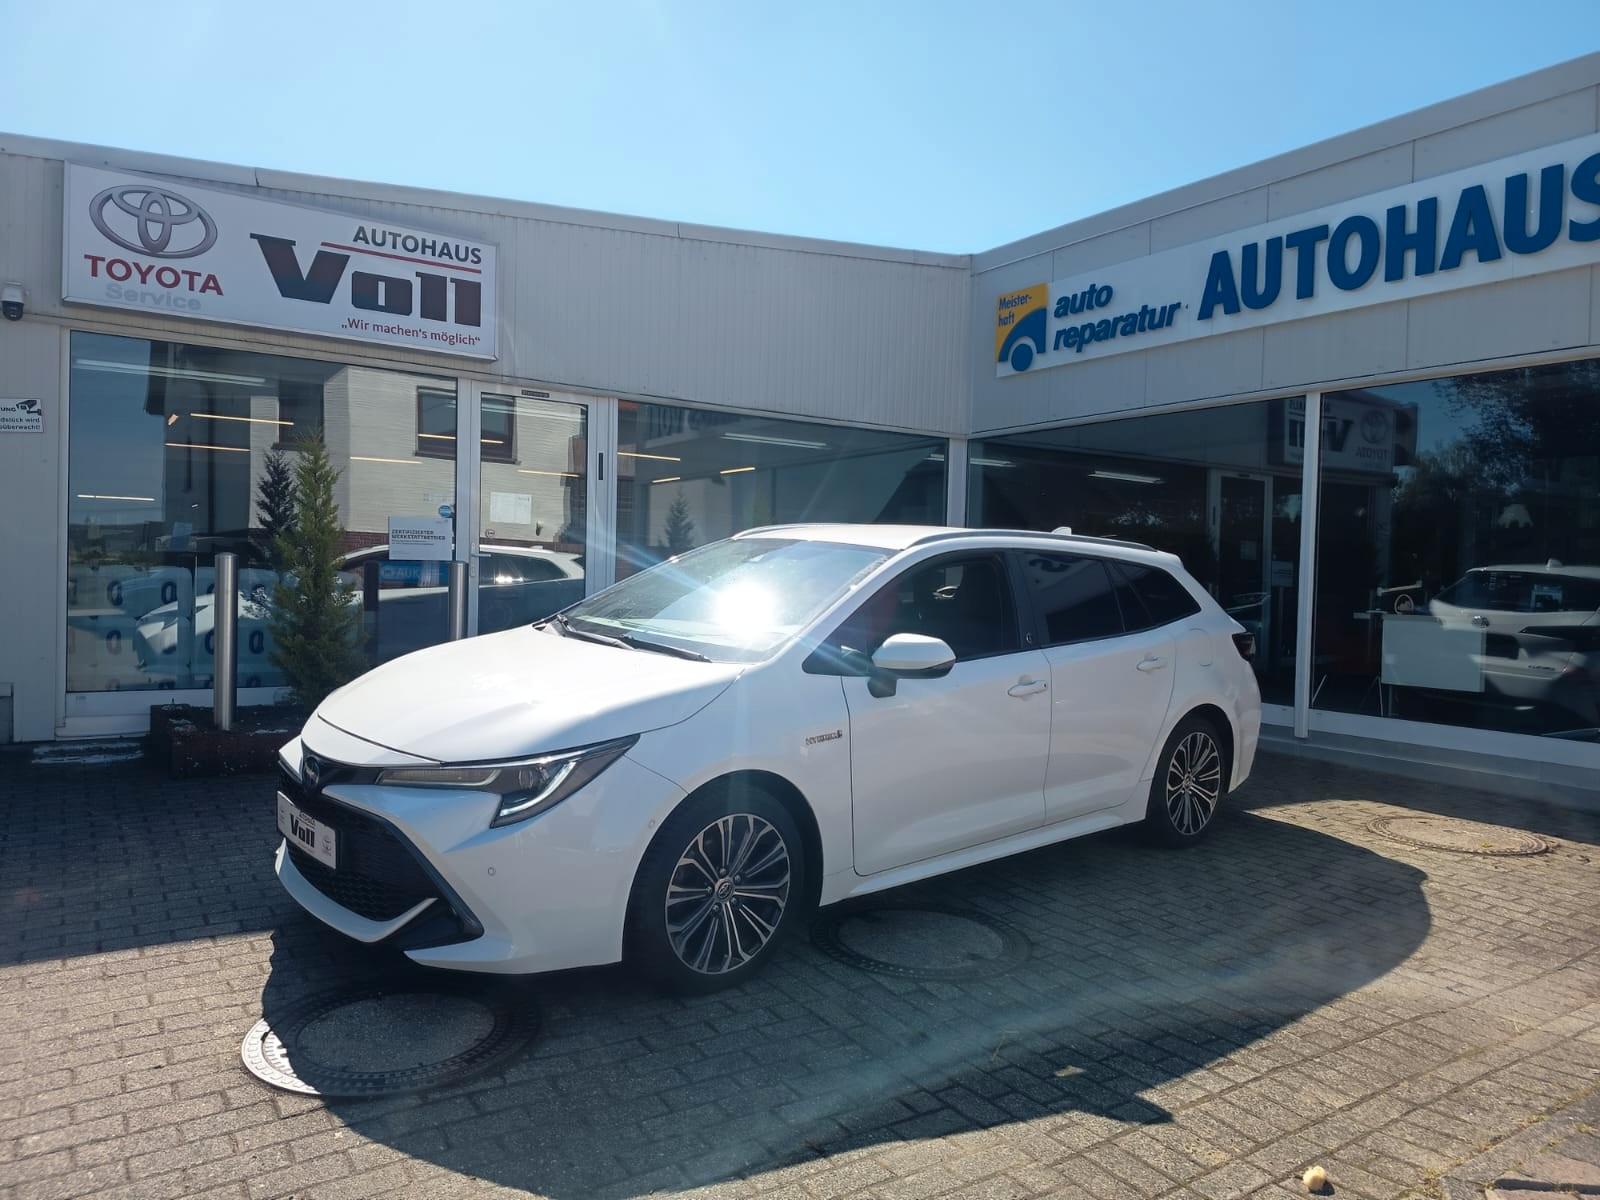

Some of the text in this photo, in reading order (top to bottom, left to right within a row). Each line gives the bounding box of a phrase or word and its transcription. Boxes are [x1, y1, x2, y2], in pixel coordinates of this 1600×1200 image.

[352, 225, 482, 265] AUTOHAUS
[84, 254, 224, 296] TOYOTA
[250, 232, 482, 328] Voll
[105, 282, 202, 310] Service
[998, 293, 1032, 311] Meister-
[1054, 283, 1114, 318] auto
[372, 322, 428, 339] machen's
[998, 311, 1015, 328] haft
[1053, 301, 1182, 353] reparatur
[290, 813, 315, 848] Voll
